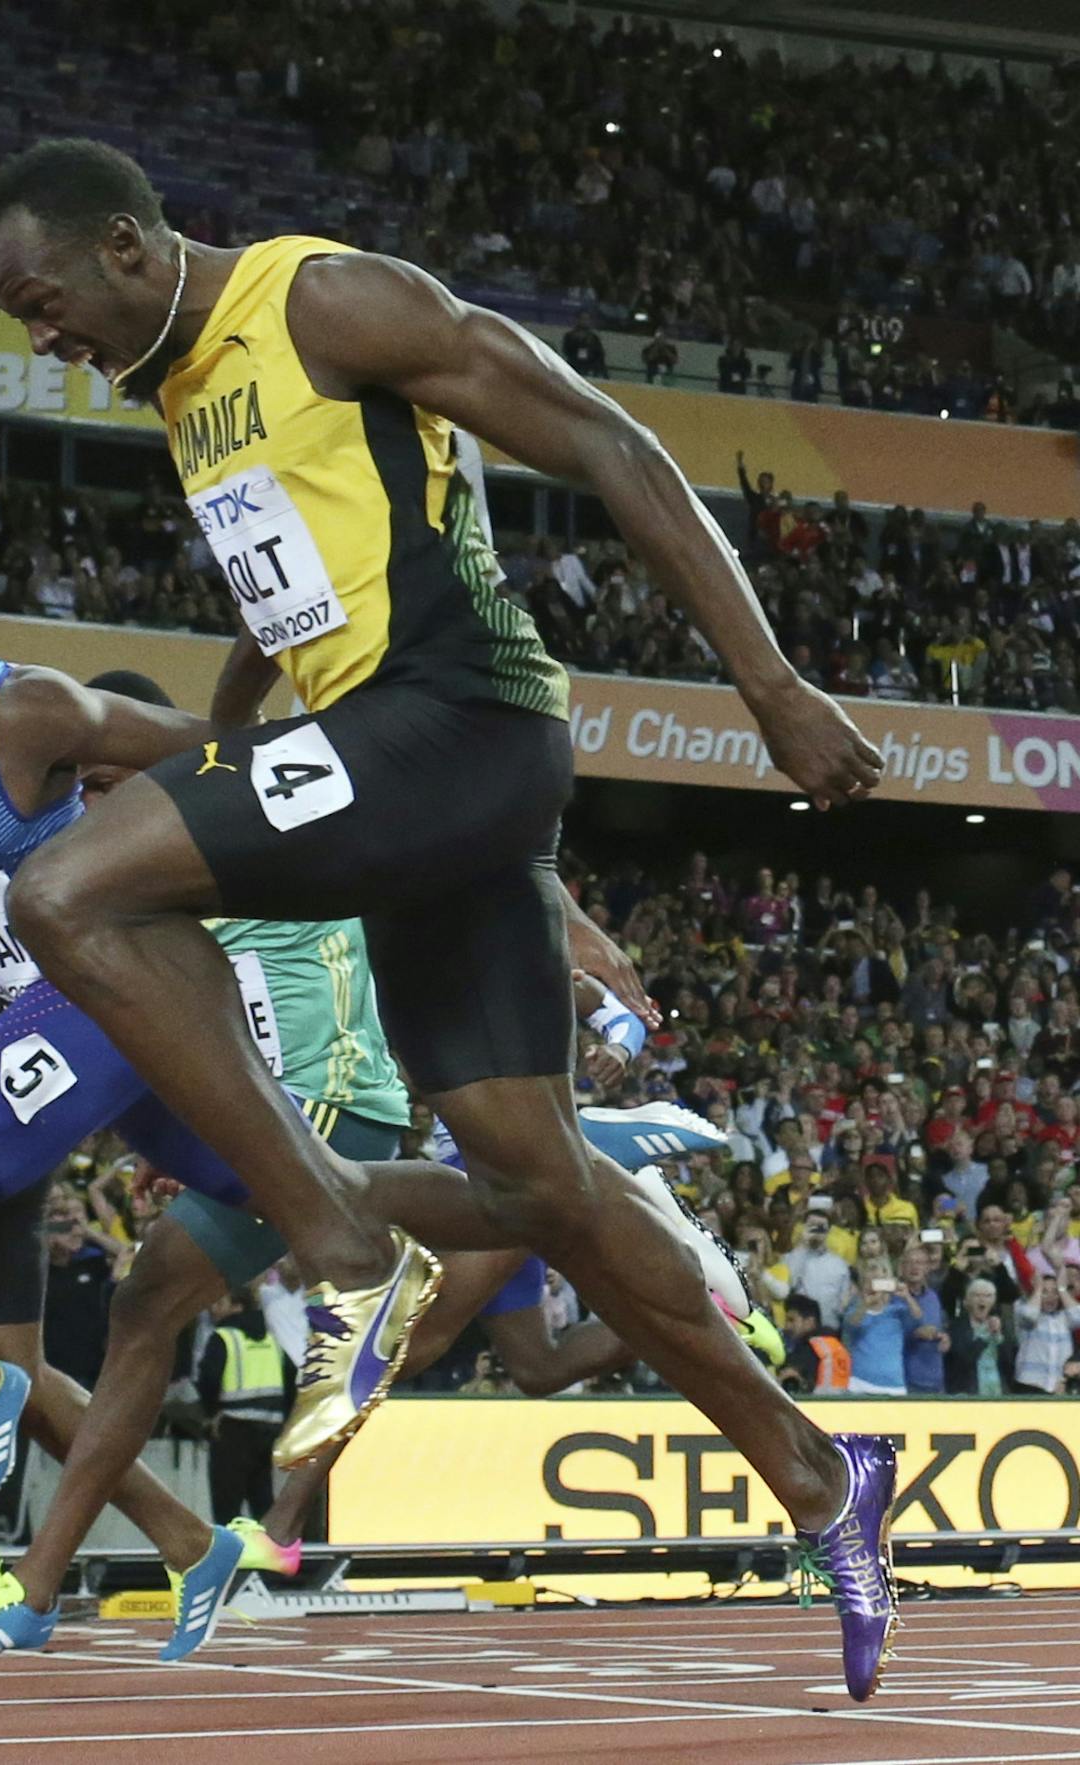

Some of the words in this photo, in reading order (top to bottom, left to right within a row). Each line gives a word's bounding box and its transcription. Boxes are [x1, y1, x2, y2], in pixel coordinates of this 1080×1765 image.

[206, 482, 264, 529] TDK
[285, 600, 330, 638] 2017
[265, 763, 334, 800] 4
[5, 1049, 60, 1099] 5
[542, 1429, 1080, 1539] SEKO
[838, 1511, 889, 1617] FOREVE
